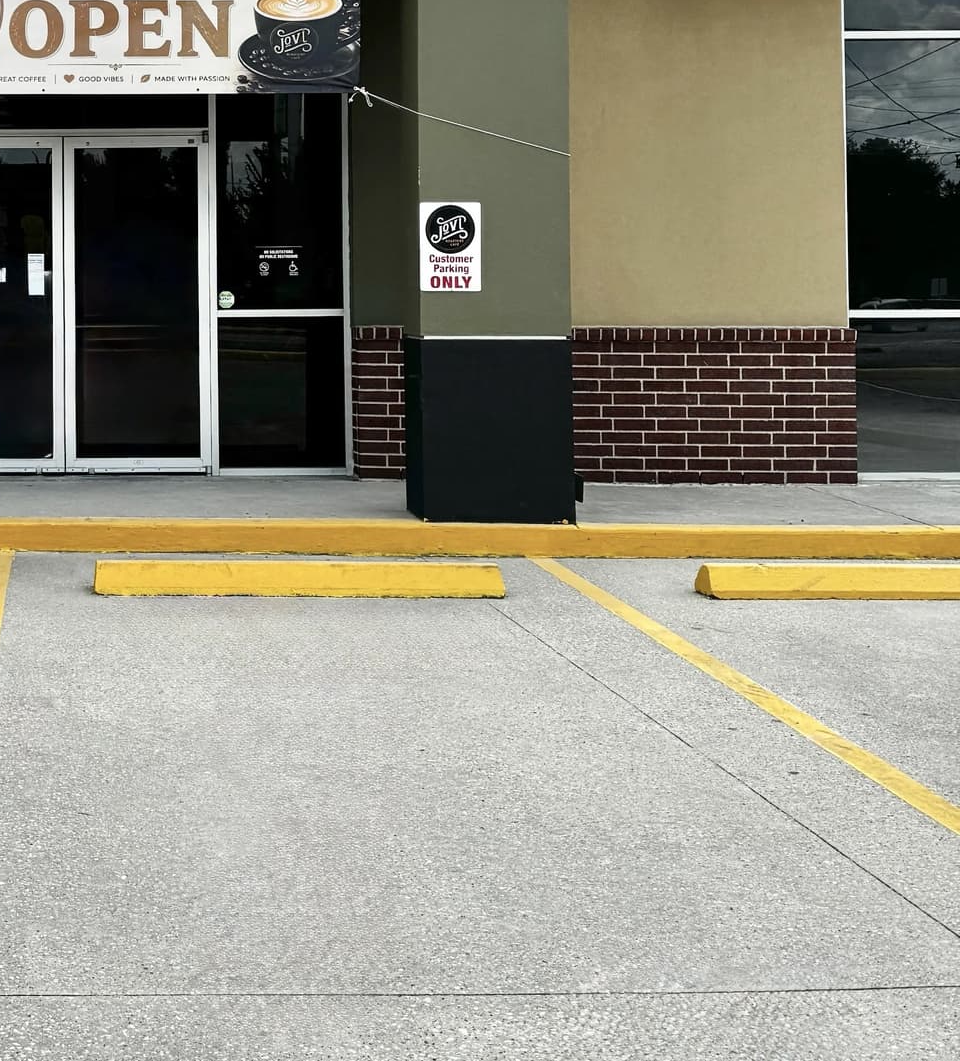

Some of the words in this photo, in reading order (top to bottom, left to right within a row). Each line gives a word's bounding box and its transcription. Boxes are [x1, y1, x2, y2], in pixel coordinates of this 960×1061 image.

[9, 0, 235, 59] OPEN
[429, 254, 474, 263] Customer
[433, 264, 469, 274] Parking
[430, 275, 472, 289] ONLY
